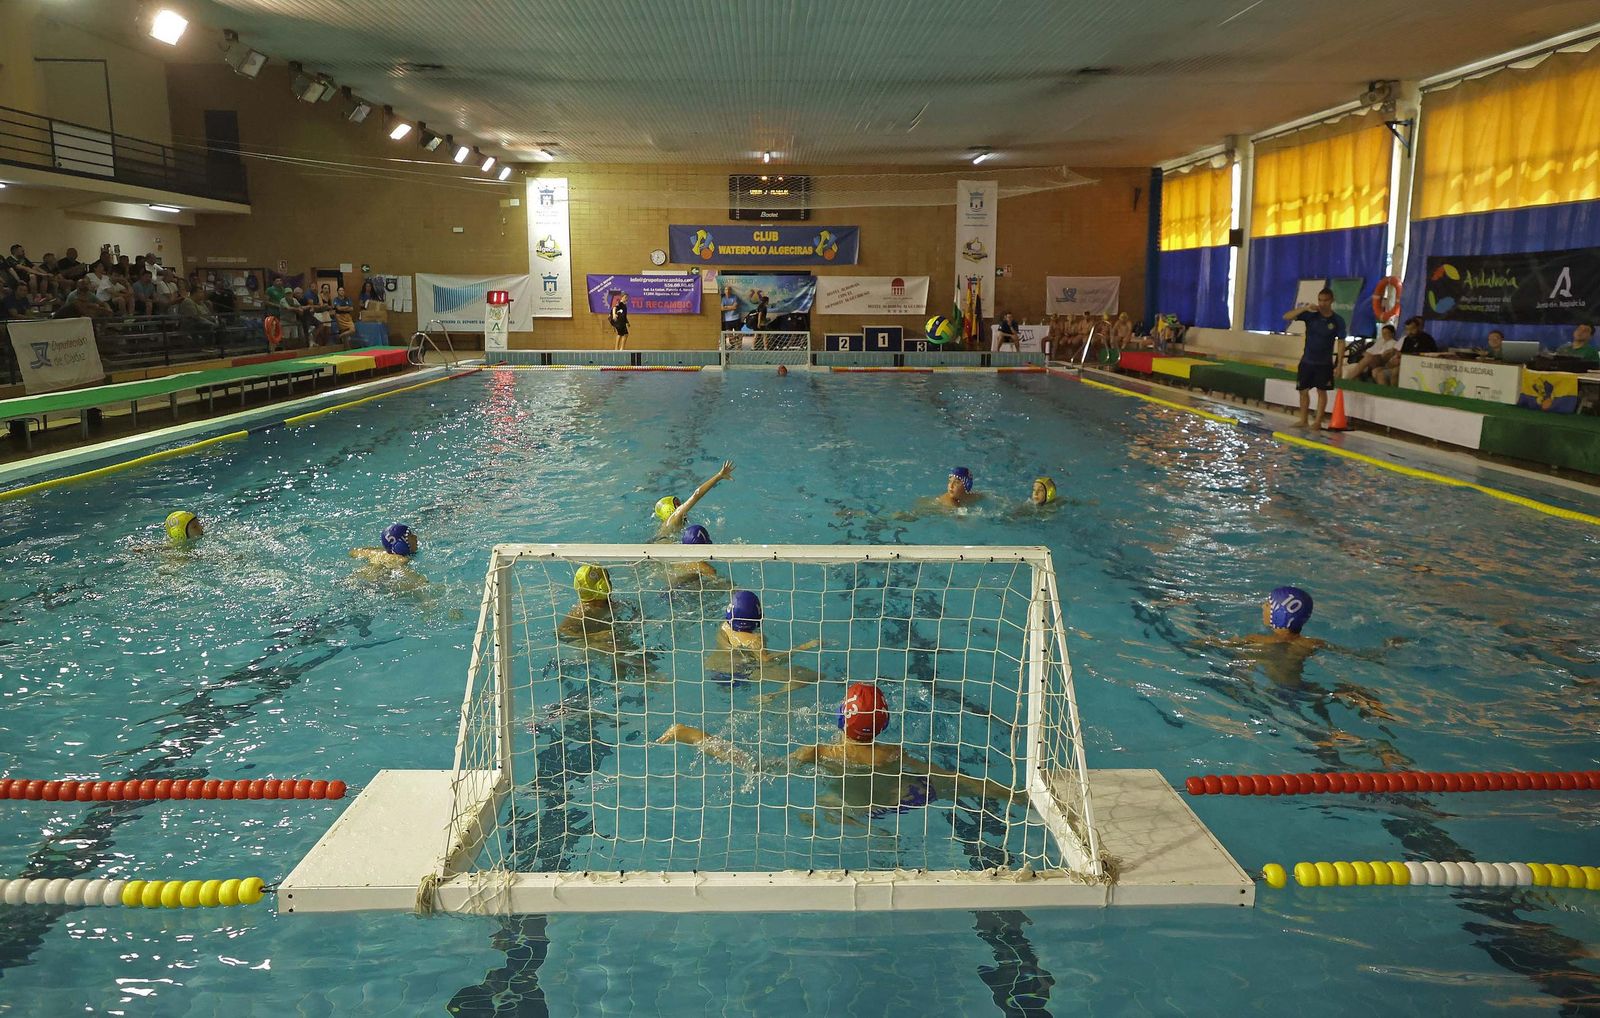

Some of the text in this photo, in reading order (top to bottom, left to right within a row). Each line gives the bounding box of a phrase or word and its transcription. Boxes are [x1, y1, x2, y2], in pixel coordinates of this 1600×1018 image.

[753, 231, 779, 242] CLUB
[718, 245, 813, 256] WATERPOLO ALGECIRAS
[493, 292, 505, 303] 11
[631, 299, 693, 309] TU RECAMBIO
[840, 339, 848, 349] 2
[880, 336, 886, 345] 1
[918, 342, 925, 352] 3
[1421, 361, 1434, 369] CLUB
[385, 533, 396, 545] 5
[1281, 594, 1303, 614] 10
